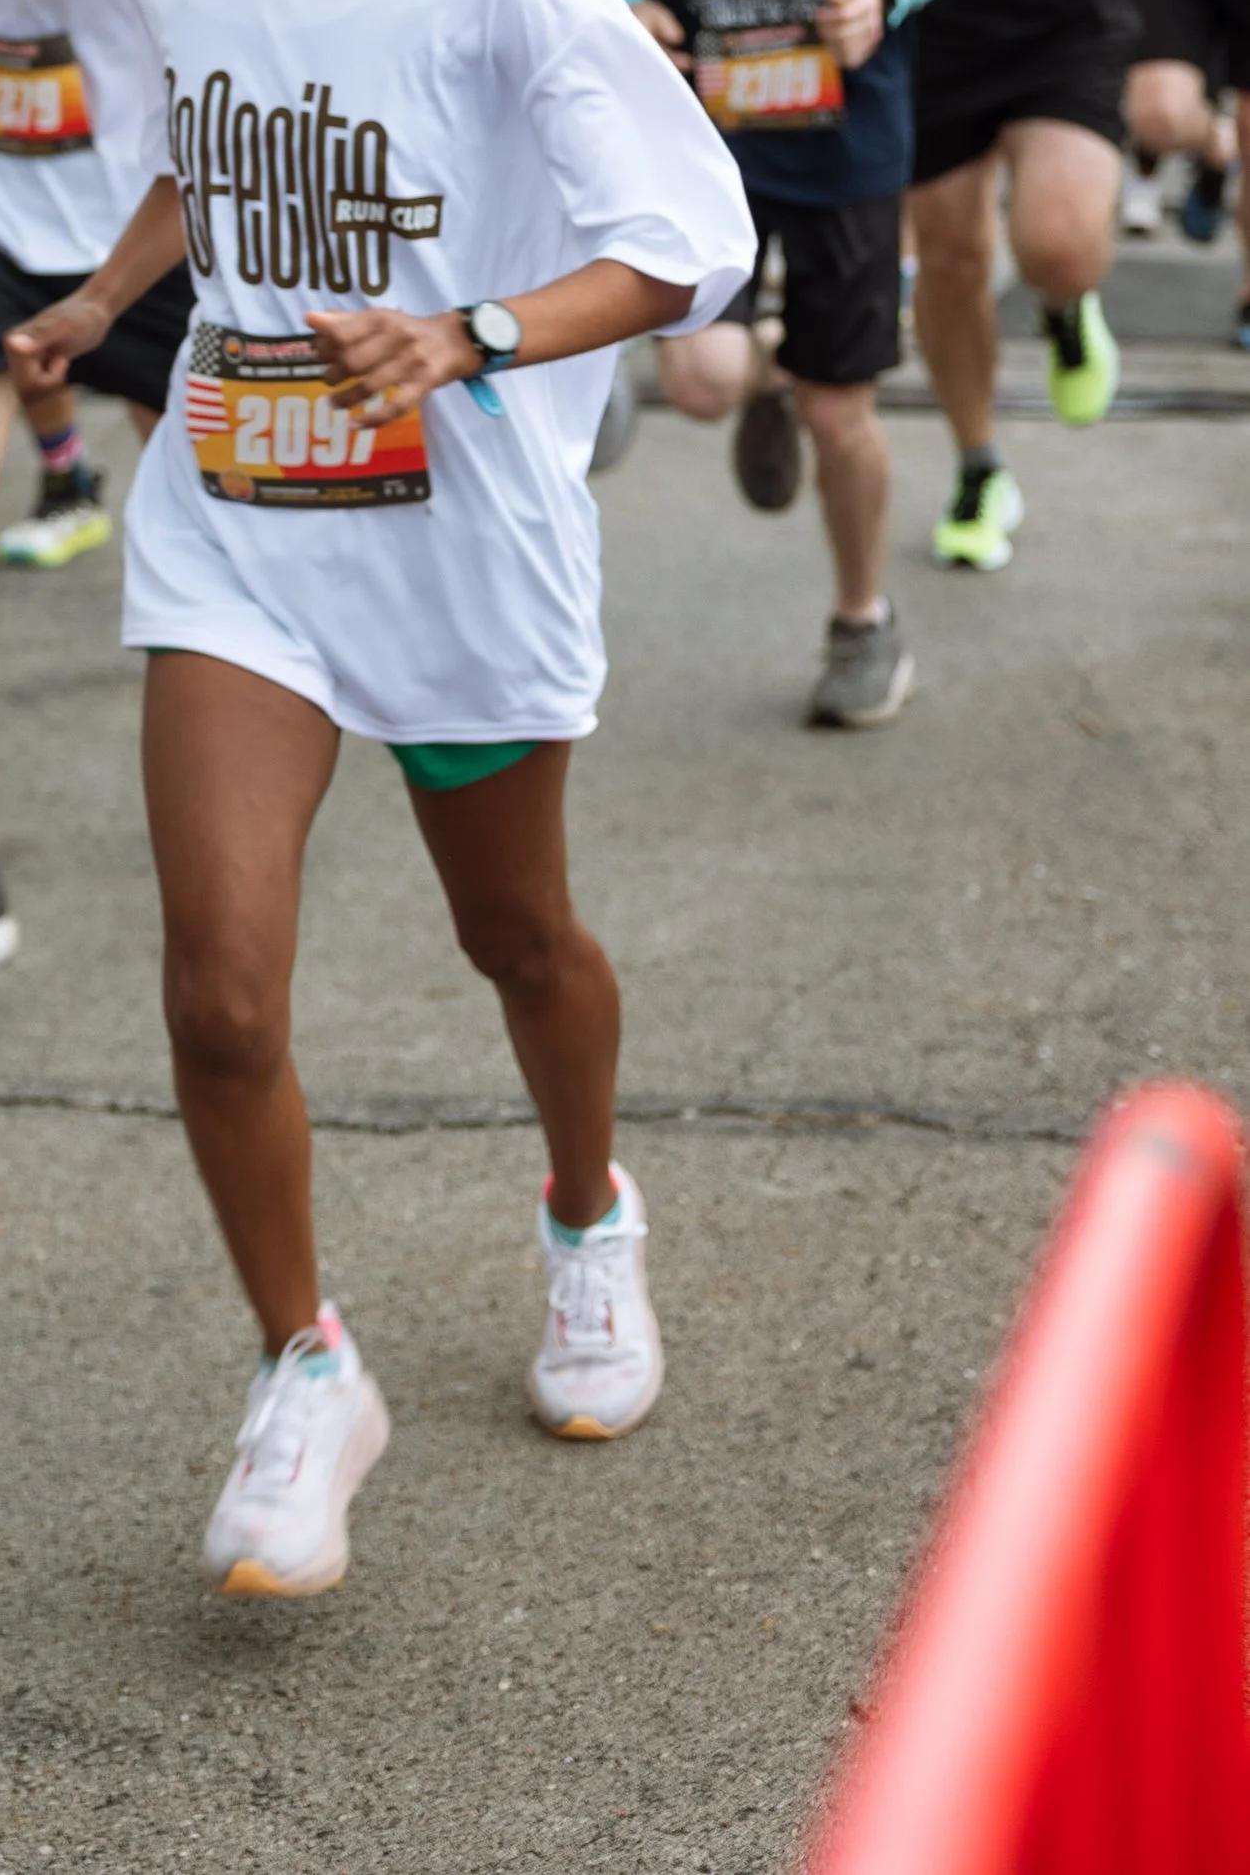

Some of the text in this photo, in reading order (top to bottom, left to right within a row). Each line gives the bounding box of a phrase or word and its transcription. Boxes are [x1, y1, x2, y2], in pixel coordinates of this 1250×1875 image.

[335, 198, 438, 231] RUN CLUB
[234, 390, 385, 468] 2097
